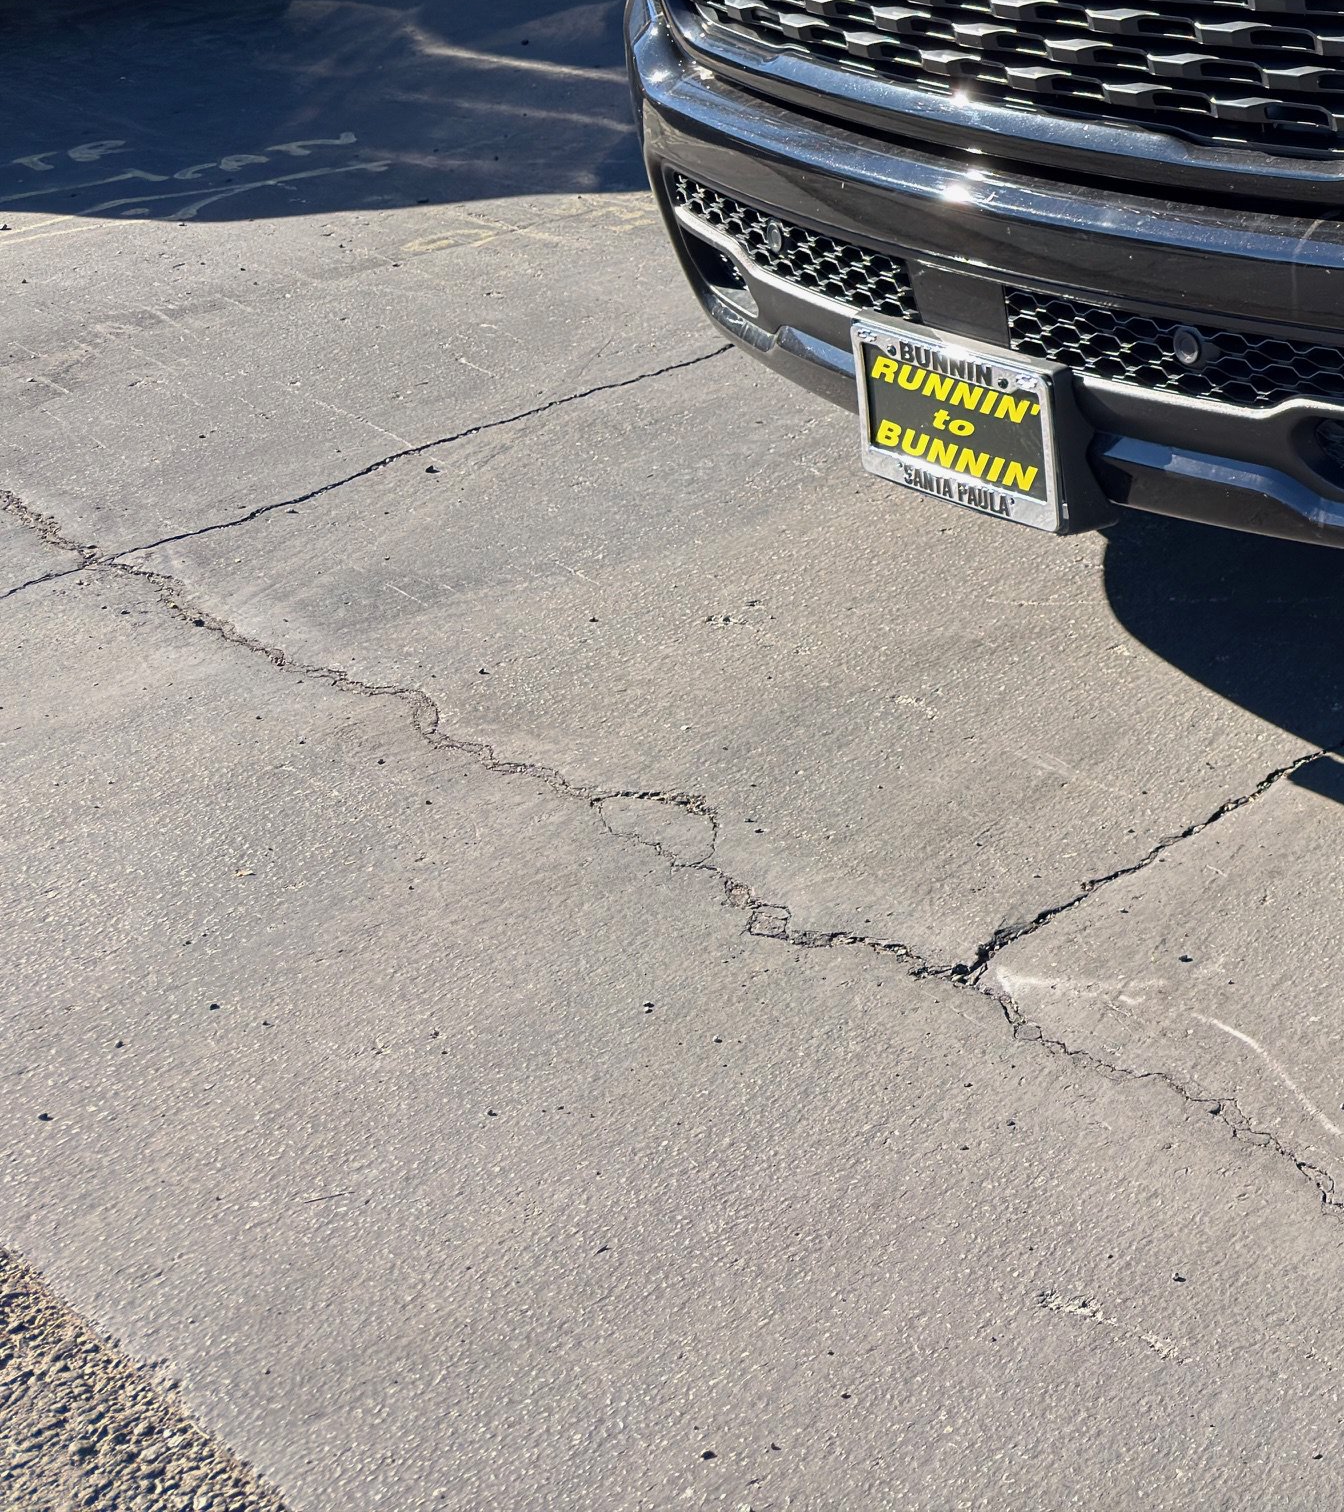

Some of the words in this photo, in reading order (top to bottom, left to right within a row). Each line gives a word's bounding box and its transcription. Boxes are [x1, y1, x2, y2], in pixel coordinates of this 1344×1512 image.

[871, 355, 1041, 424] RUNNIN'
[899, 340, 993, 388] BUNNIN
[932, 409, 975, 437] to
[875, 419, 1039, 492] BUNNIN
[903, 465, 953, 499] SANTA
[957, 483, 1011, 517] PAULA
